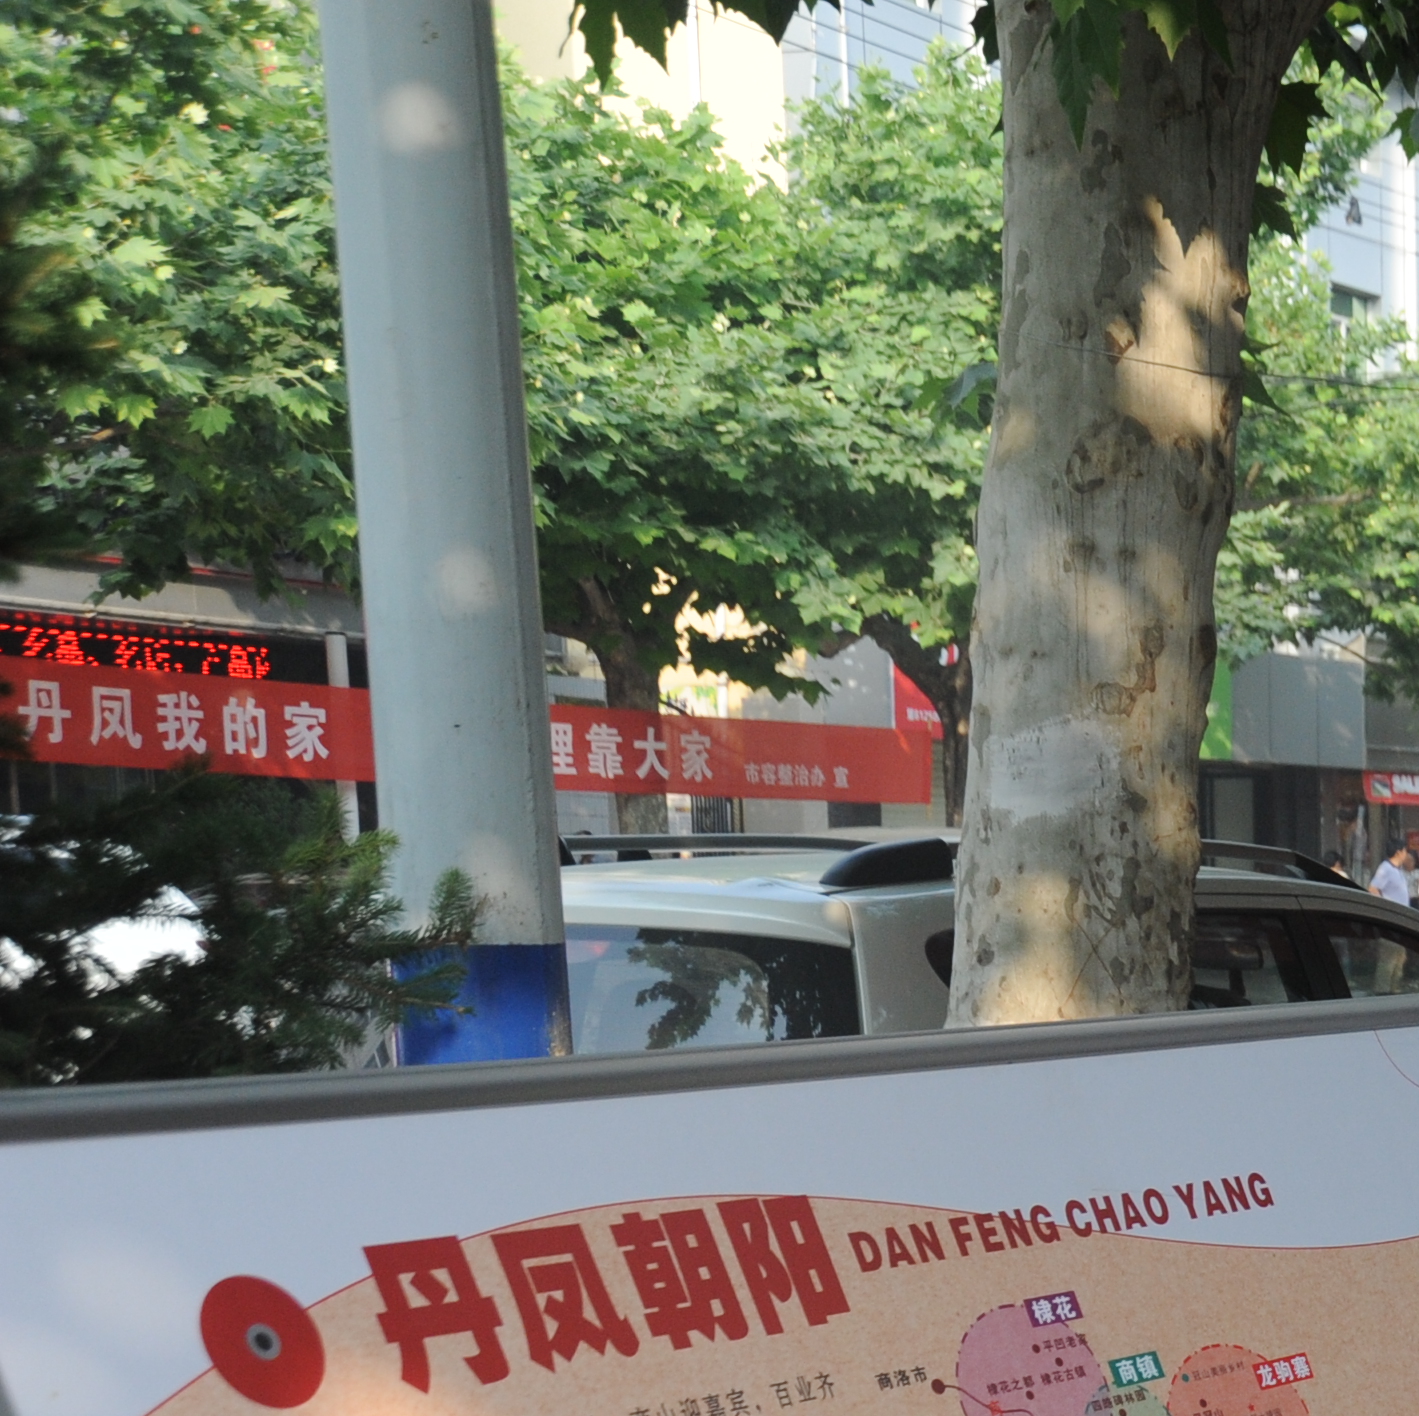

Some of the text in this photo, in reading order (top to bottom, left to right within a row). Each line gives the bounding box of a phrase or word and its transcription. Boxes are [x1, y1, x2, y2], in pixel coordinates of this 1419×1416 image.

[18, 679, 330, 763] 丹凤我的家
[744, 761, 826, 789] 市容整治办
[833, 765, 850, 788] 宣
[847, 1171, 1276, 1274] DAN FENG CHAO YANG
[362, 1195, 851, 1395] 丹凤朝阳
[1031, 1295, 1078, 1326] 棣花
[874, 1364, 928, 1392] 商洛市
[1115, 1355, 1159, 1385] 商镇
[1256, 1356, 1312, 1390] 龙驹寨
